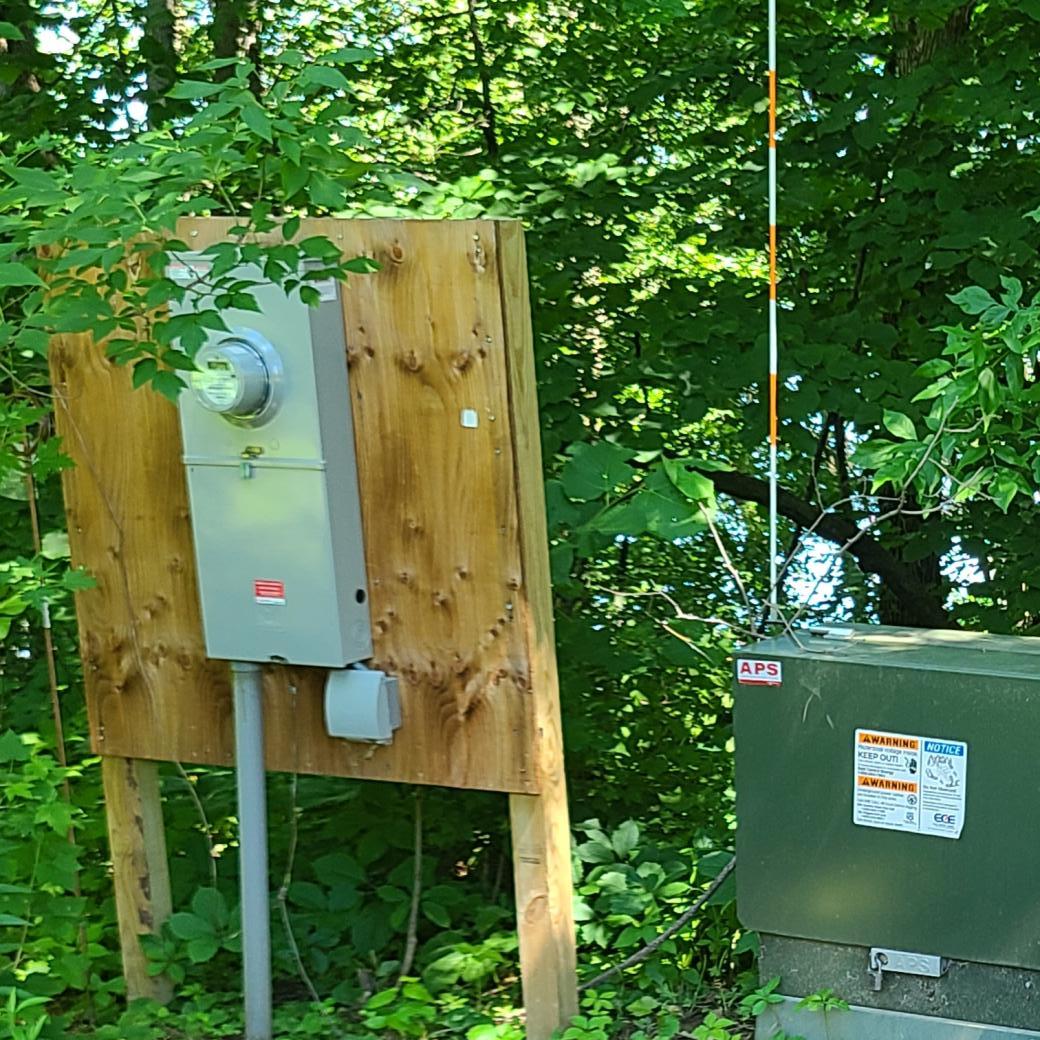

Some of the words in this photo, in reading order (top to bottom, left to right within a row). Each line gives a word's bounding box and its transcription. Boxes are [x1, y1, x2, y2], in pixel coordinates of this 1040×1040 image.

[740, 661, 778, 676] APS
[870, 735, 916, 749] WARNING
[926, 742, 961, 755] NOTICE
[858, 751, 879, 760] KEEP
[880, 754, 899, 763] OUT!
[869, 778, 915, 792] WARNING
